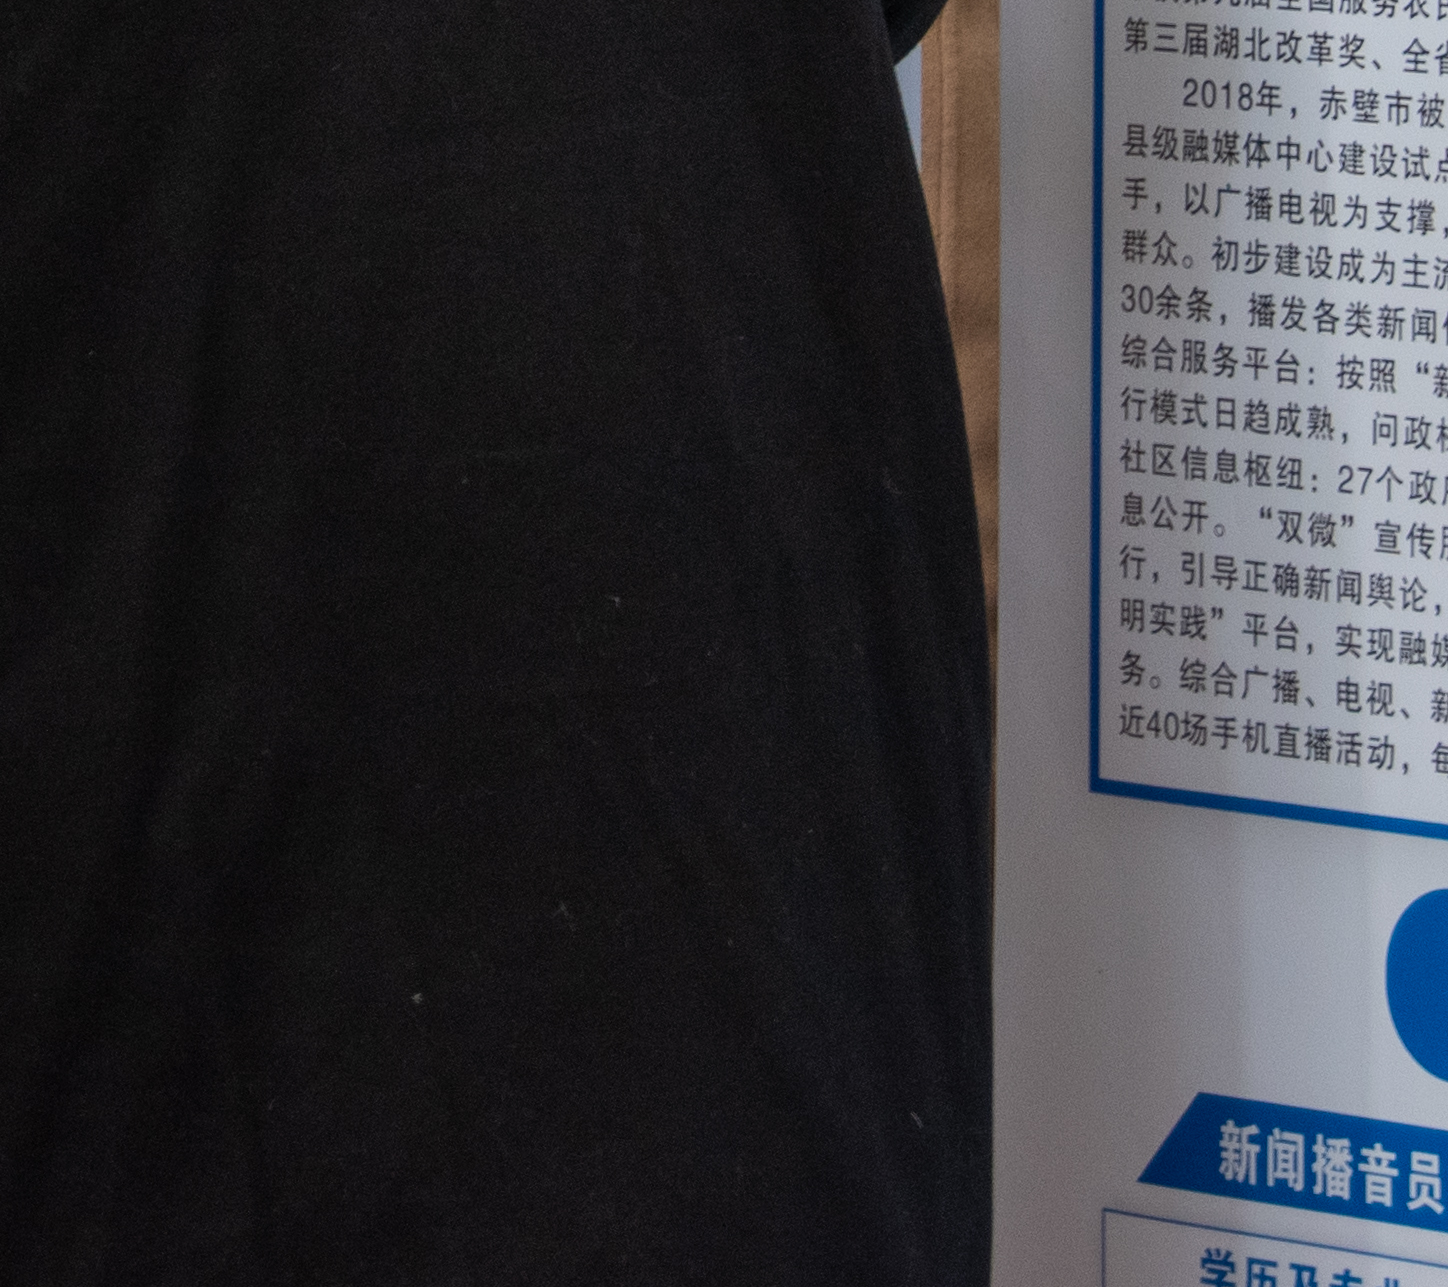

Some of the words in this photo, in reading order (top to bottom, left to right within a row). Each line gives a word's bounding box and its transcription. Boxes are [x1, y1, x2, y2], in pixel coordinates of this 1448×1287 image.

[1219, 1119, 1446, 1215] 新闻播音员
[1199, 1246, 1400, 1287] 学历及
